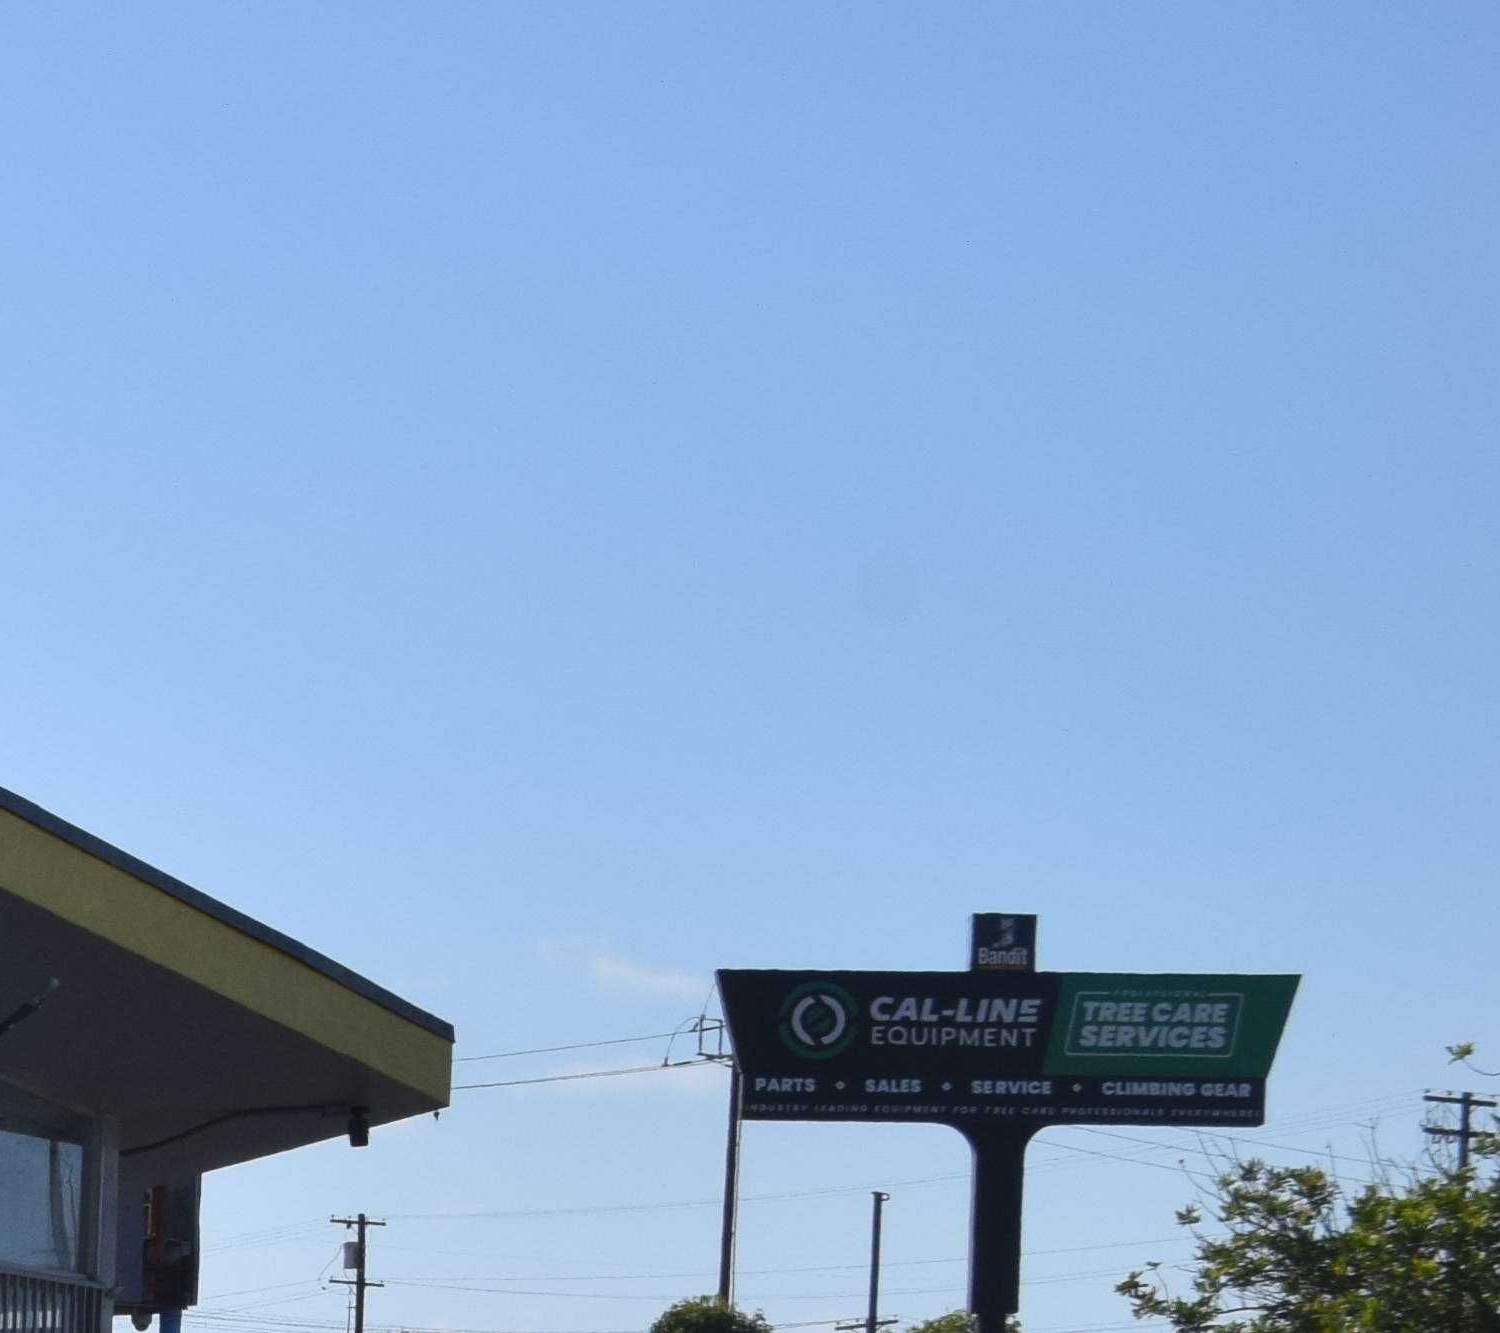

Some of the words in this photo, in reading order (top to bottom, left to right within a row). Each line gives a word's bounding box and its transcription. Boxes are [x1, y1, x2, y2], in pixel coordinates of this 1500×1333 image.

[978, 947, 1028, 966] Bandit
[869, 996, 1042, 1024] CAL-LINE
[1083, 1001, 1149, 1023] TREE
[1152, 1002, 1230, 1024] CARE
[871, 1026, 1037, 1048] EQUIPMENT
[1079, 1025, 1229, 1049] SERVICES
[755, 1078, 816, 1093] PARTS
[865, 1079, 922, 1093] SALES
[971, 1080, 1053, 1095] SERVICE
[1101, 1081, 1196, 1096] CLIMBING
[1200, 1082, 1251, 1098] GEAR
